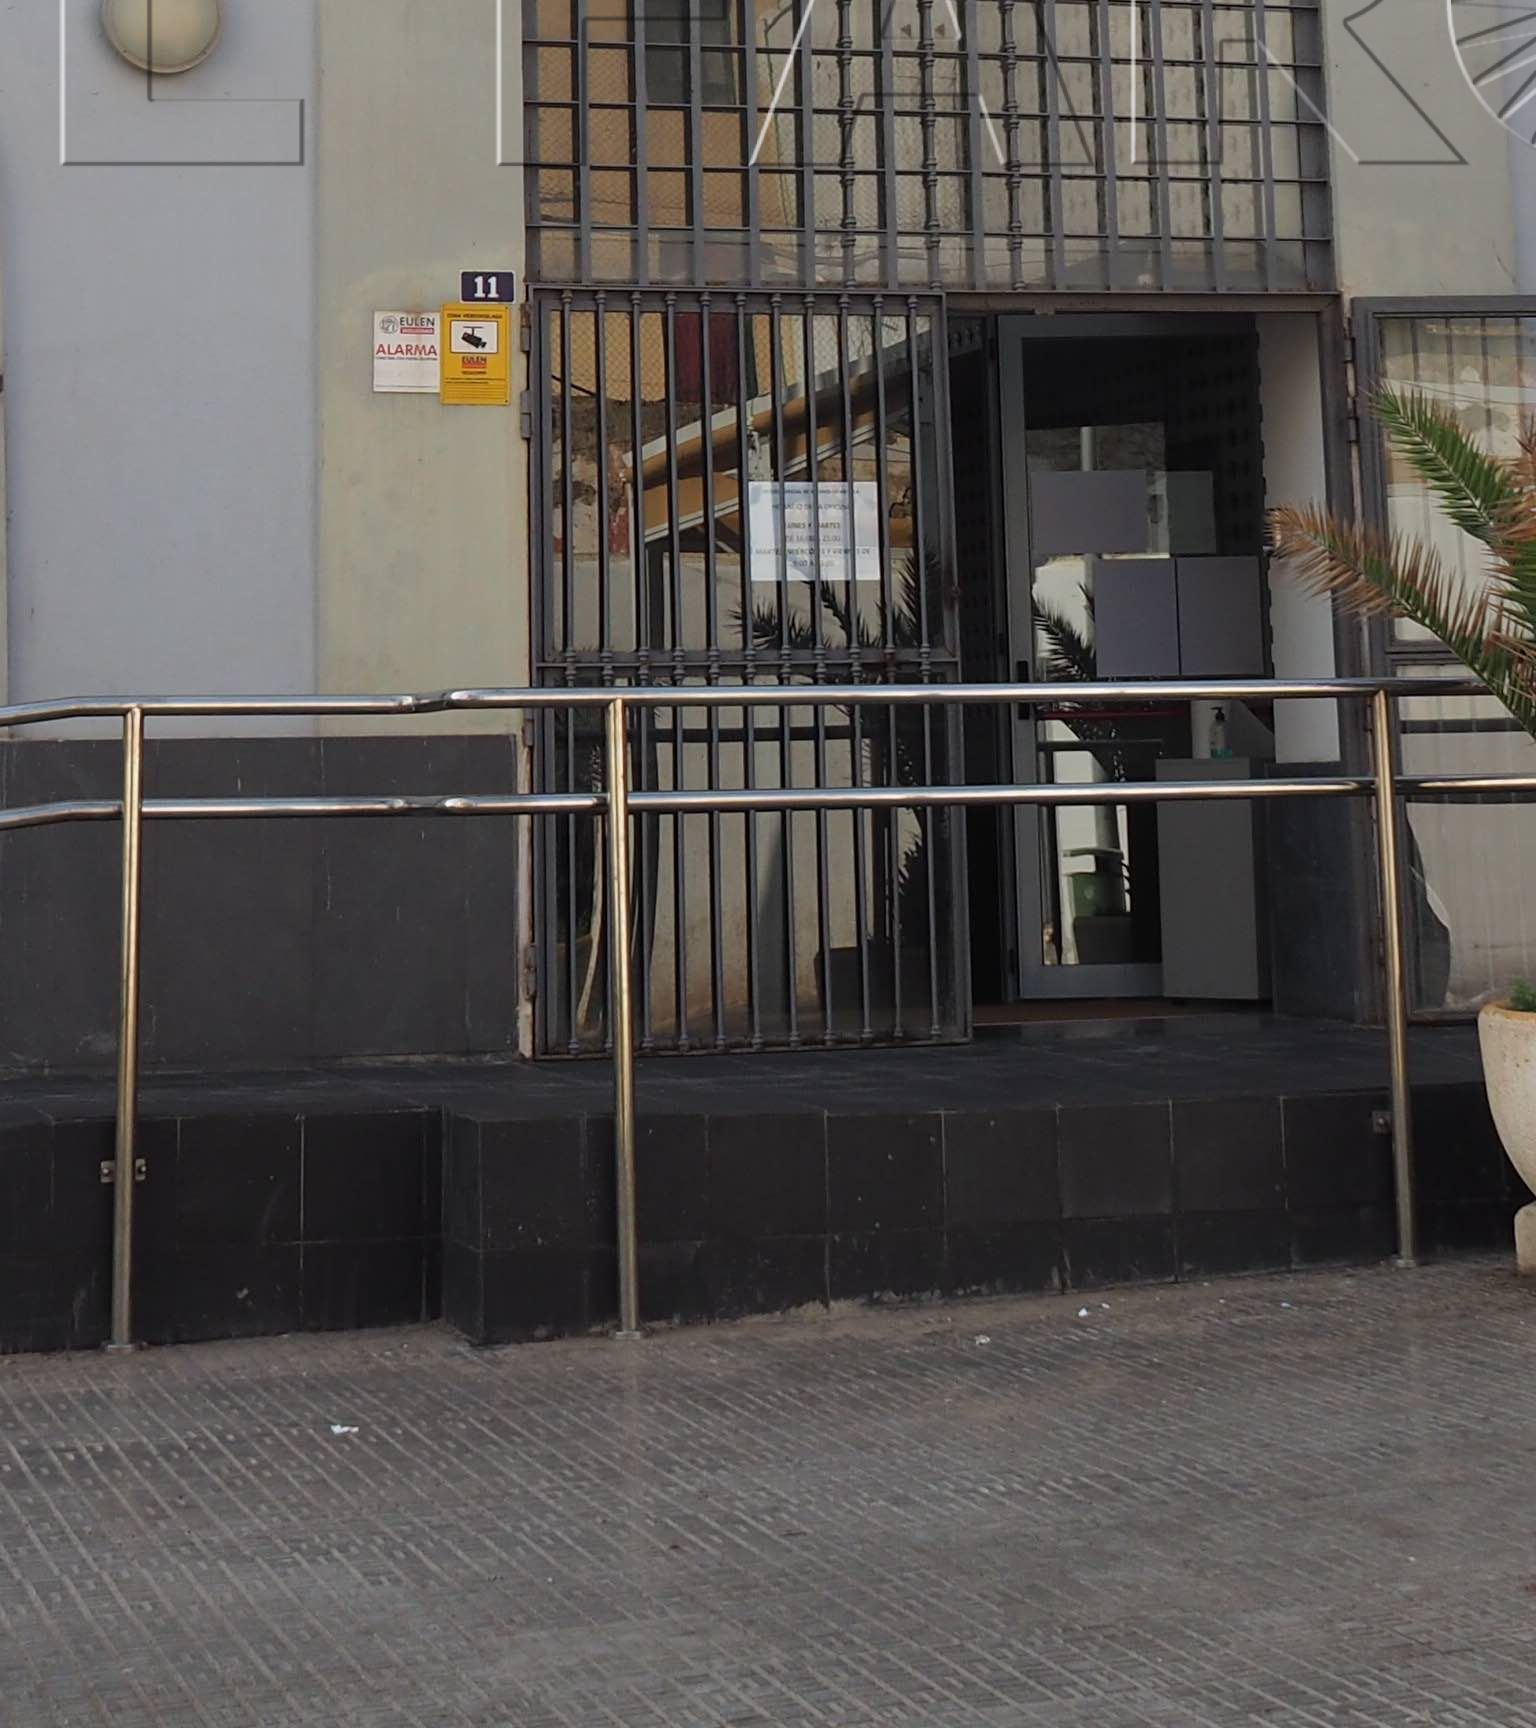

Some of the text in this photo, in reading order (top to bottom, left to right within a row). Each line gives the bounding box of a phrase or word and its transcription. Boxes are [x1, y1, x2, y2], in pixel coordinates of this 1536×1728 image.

[474, 275, 500, 299] 11
[399, 316, 435, 327] EULEN
[375, 343, 438, 356] ALARMA
